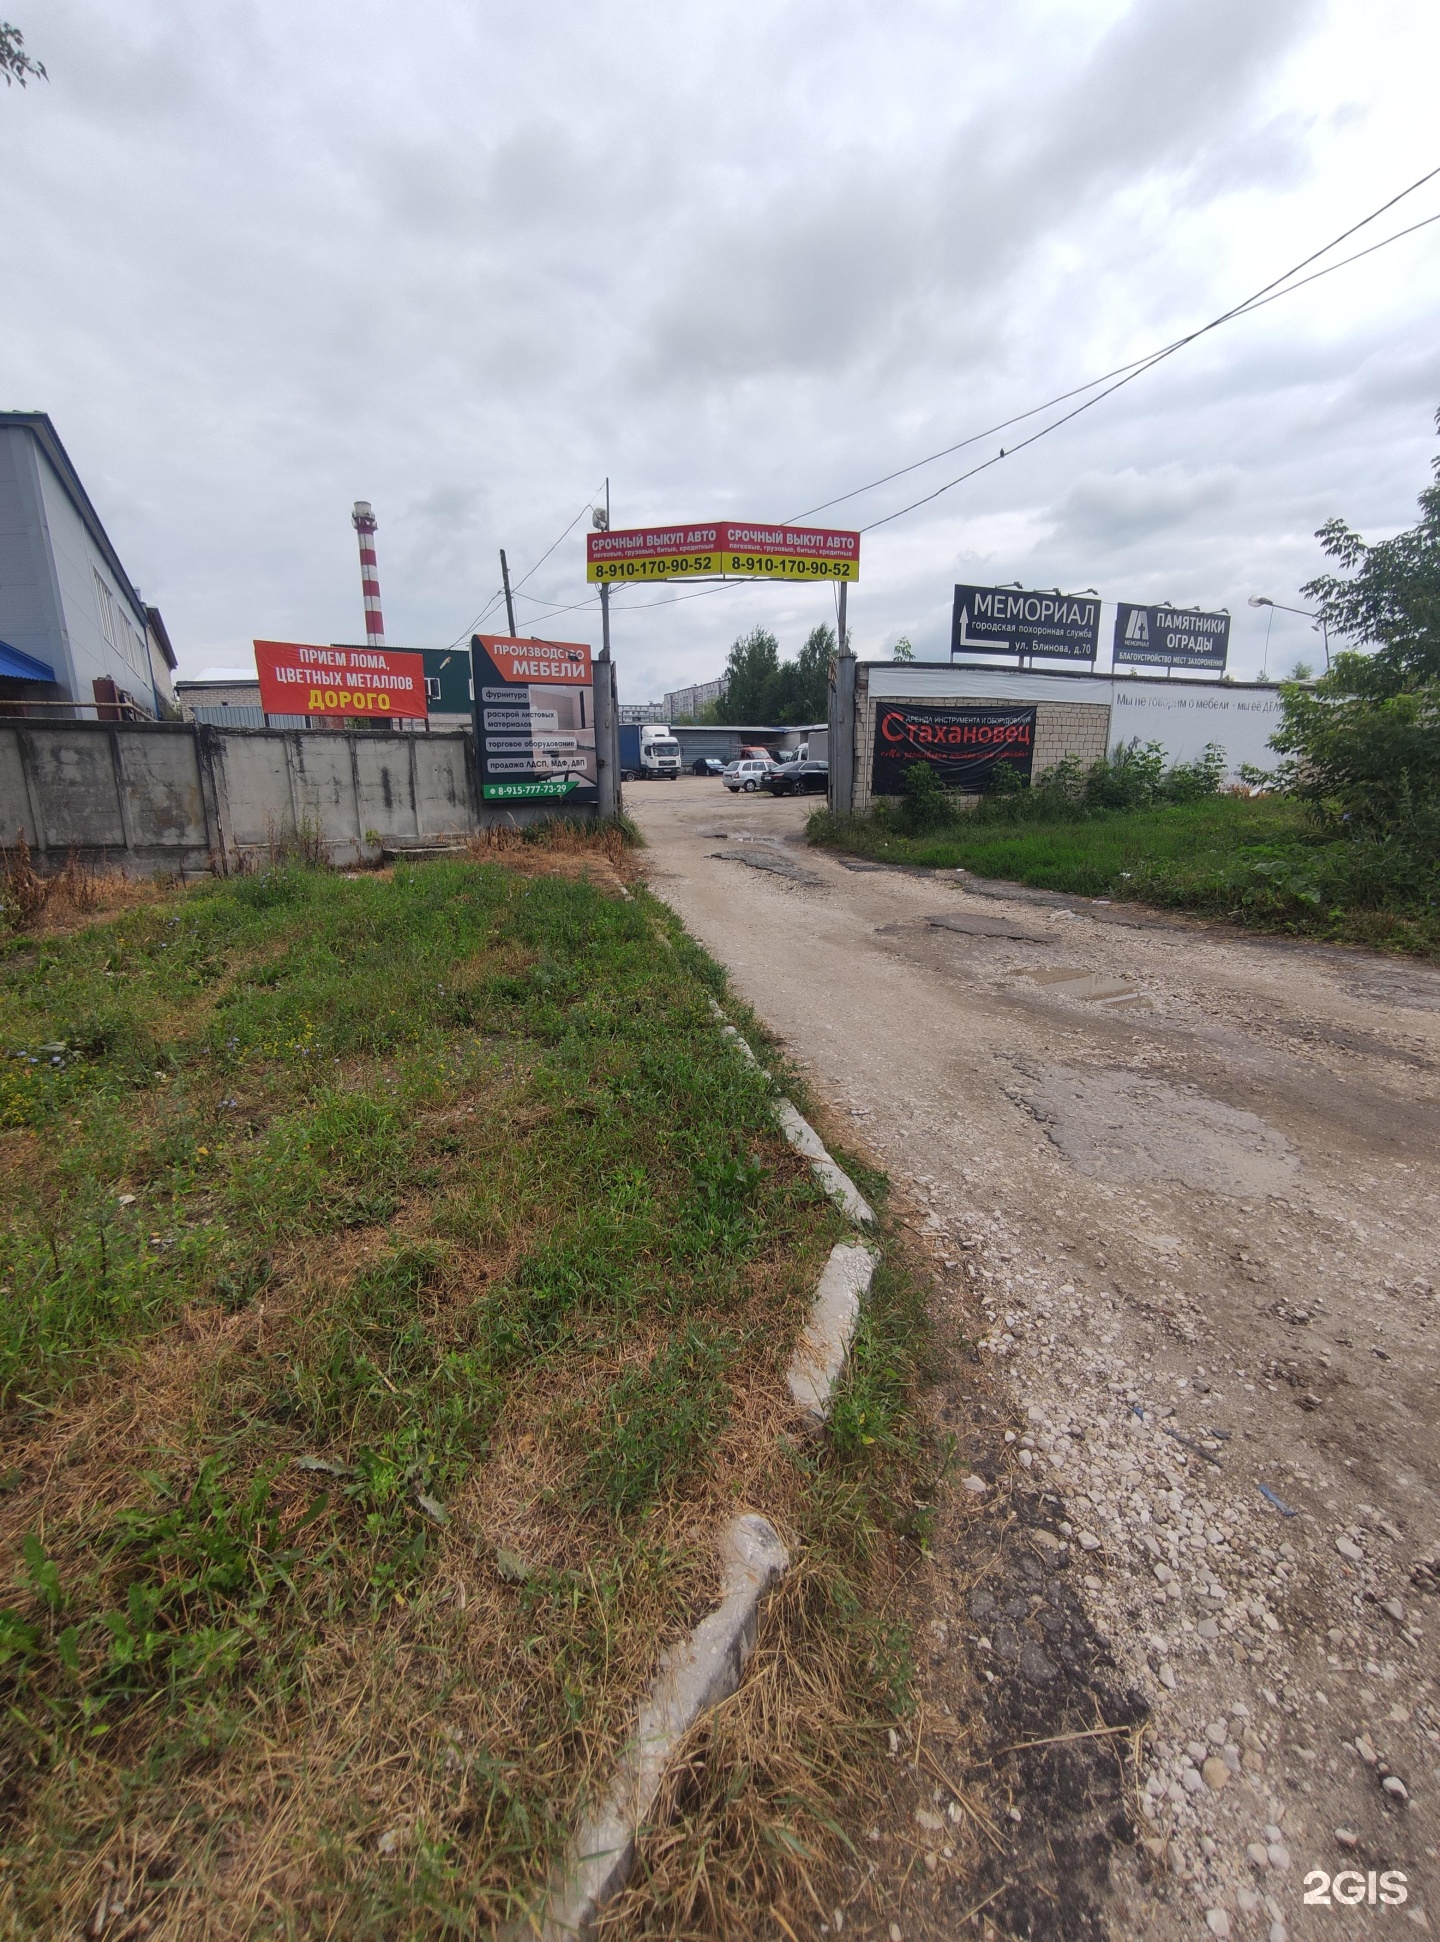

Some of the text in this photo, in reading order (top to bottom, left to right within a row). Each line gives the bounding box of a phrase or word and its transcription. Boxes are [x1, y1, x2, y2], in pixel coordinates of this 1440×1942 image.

[591, 530, 716, 551] СРОЧНЫЙ ВЫКУП АВТО
[680, 543, 714, 553] кредитные
[727, 529, 855, 549] СРОЧНЫЙ ВЫКУП АВТО
[819, 549, 853, 557] кредитные
[595, 556, 712, 578] 8-910-170-90-52
[731, 556, 850, 577] 8-910-170-90-52
[974, 593, 1095, 626] МЕМОРИАЛ
[971, 620, 1092, 639] городская похоронная служба
[1156, 613, 1226, 634] ПАМЯТНИКИ
[1015, 640, 1091, 655] ул. Блинова, д.70
[1124, 640, 1149, 648] МЕМОРИАЛ
[1166, 633, 1213, 653] ОГРАДЫ
[299, 648, 390, 671] ПРИЕМ ЛОМА,
[1119, 651, 1224, 667] БЛАГОУСТРОЙСТВО МЕСТ ЗАХОРОНЕНИЯ
[512, 660, 585, 678] МЕБЕЛИ
[275, 667, 413, 690] ЦВЕТНЫХ МЕТАЛЛОВ
[308, 689, 391, 710] ДОРОГО
[485, 690, 528, 700] фурнитура
[1116, 693, 1133, 706] Мы
[1134, 697, 1146, 706] не
[1195, 697, 1229, 710] мебели
[487, 710, 519, 719] раскрой
[905, 715, 933, 724] АРЕНДА
[934, 716, 980, 724] ИНСТРУМЕНТА
[881, 712, 1031, 745] Стахановец
[488, 740, 575, 749] торговое оборудование
[490, 761, 524, 770] продажа
[571, 759, 585, 767] ДВП
[498, 784, 567, 796] 8-915-777-73-29
